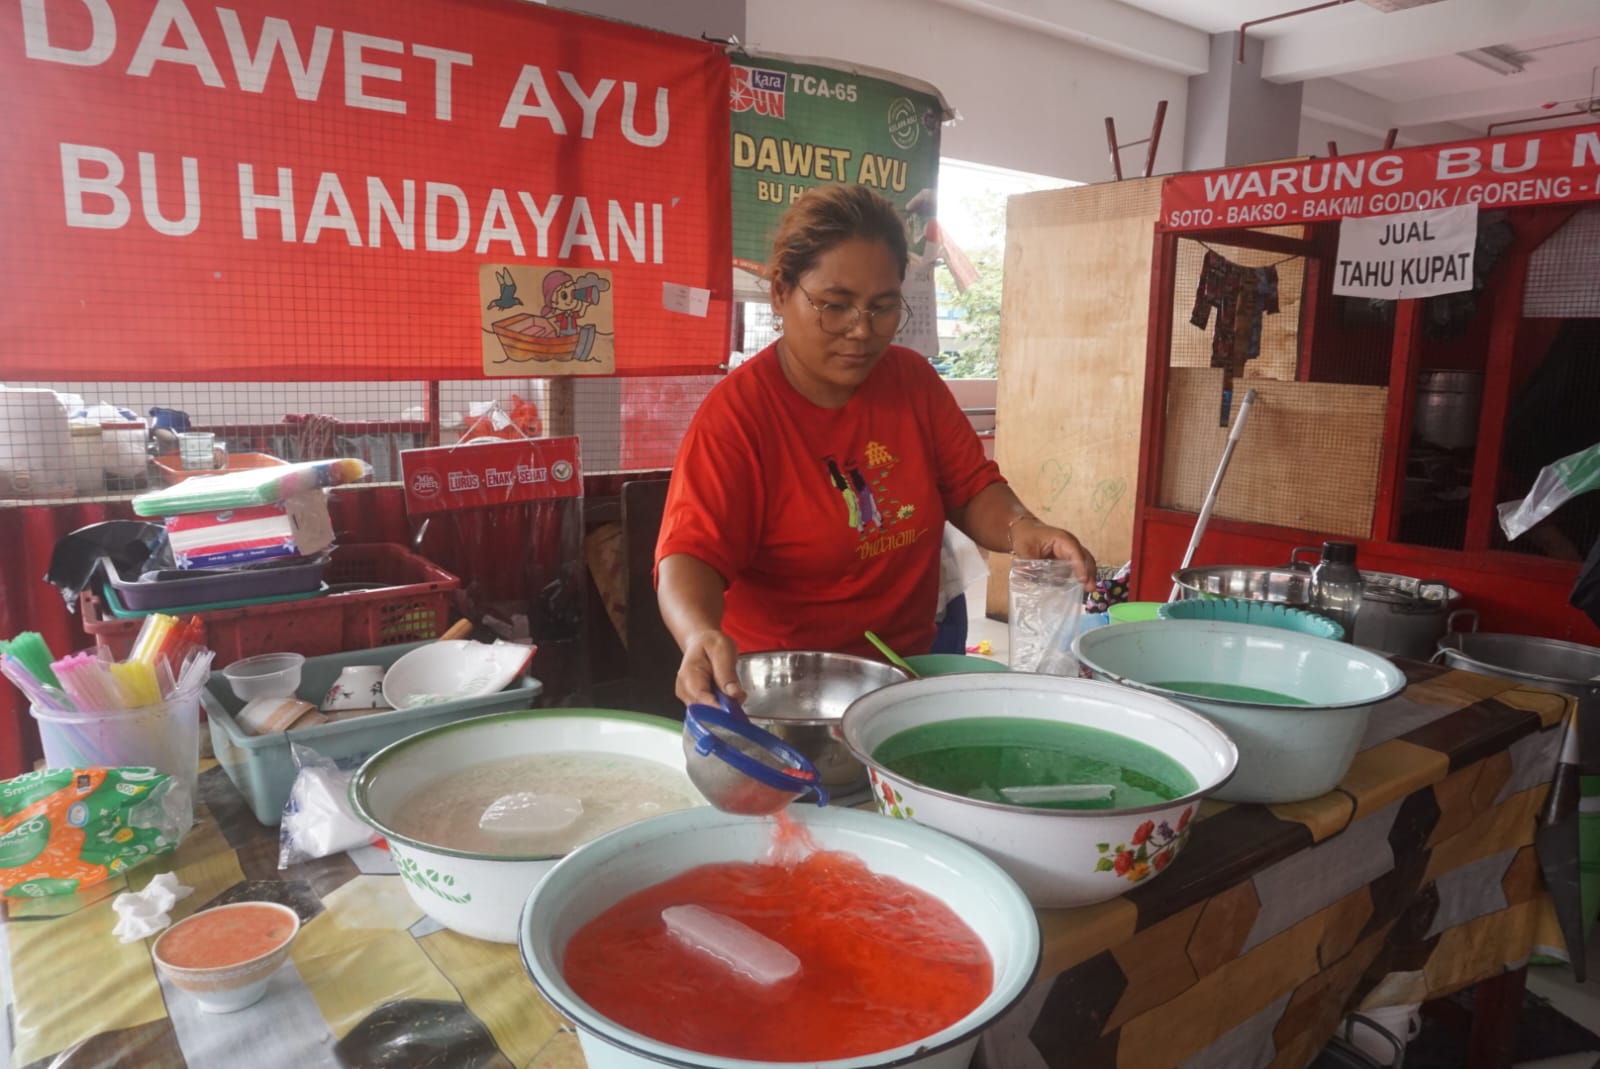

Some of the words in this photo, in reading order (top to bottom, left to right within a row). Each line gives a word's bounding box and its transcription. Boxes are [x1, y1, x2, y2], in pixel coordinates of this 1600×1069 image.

[20, 0, 472, 120] DAWET
[500, 64, 670, 148] AYU
[754, 70, 781, 88] kara
[790, 73, 858, 103] TCA-65
[732, 132, 851, 182] DAWET
[858, 153, 909, 192] AYU
[1203, 155, 1404, 202] WARUNG
[1436, 138, 1541, 180] BU
[60, 142, 201, 237] BU
[238, 162, 663, 264] HANDAYANI
[757, 180, 784, 204] BU
[1169, 209, 1214, 228] SOTO
[1226, 202, 1288, 224] BAKSO
[1302, 194, 1364, 218] BAKMI
[1369, 188, 1447, 213] GODOK
[1465, 175, 1571, 205] GORENG
[1378, 220, 1436, 247] JUAL
[1339, 258, 1395, 288] TAHU
[1400, 252, 1471, 288] KUPAT
[450, 475, 479, 490] LURUS
[487, 472, 511, 486] ENAK
